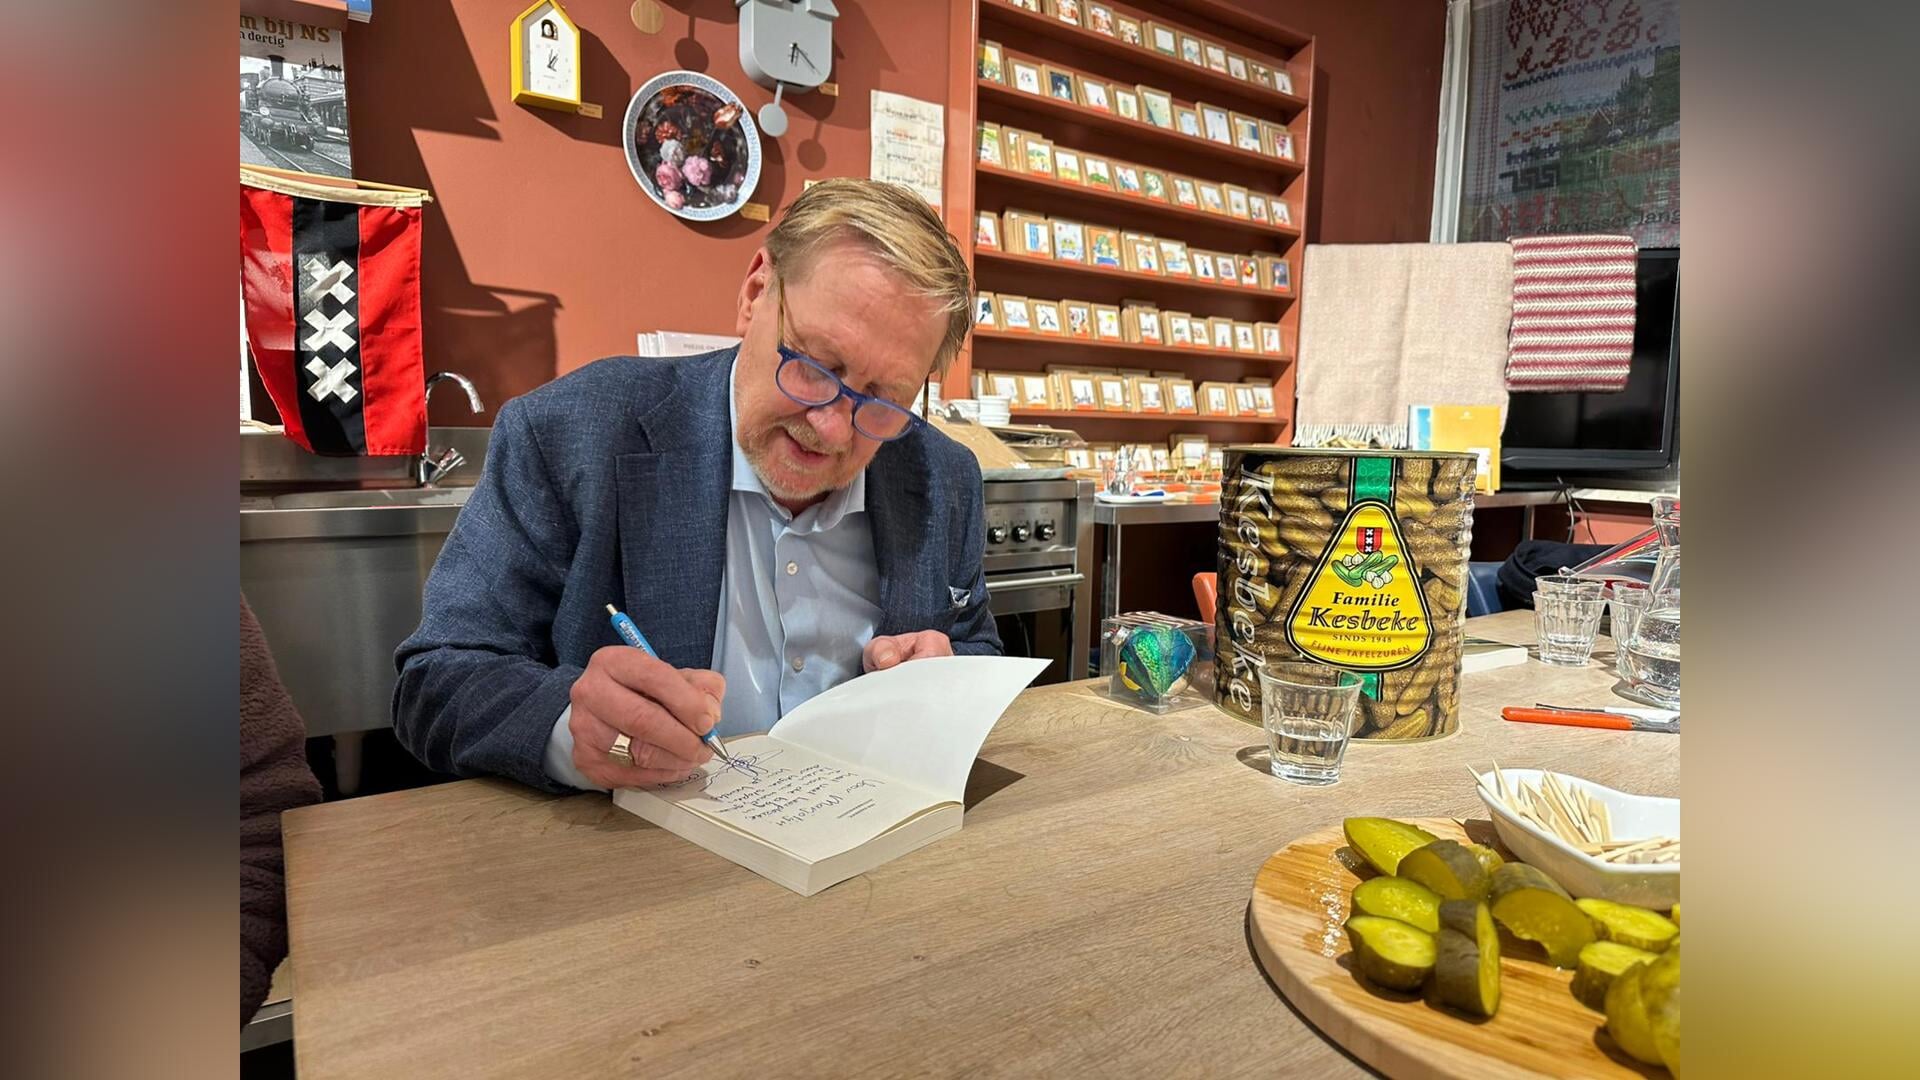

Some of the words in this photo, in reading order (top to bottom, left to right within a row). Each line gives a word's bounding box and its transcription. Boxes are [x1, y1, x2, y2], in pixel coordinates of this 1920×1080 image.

[263, 16, 294, 41] bij
[299, 23, 331, 43] NS
[248, 31, 285, 48] dertig
[1229, 464, 1275, 711] Kesbeke
[1332, 591, 1400, 607] Familie
[1307, 606, 1420, 631] Kesbeke
[1332, 633, 1368, 643] SINDS
[1346, 644, 1412, 659] TAFELZUREN
